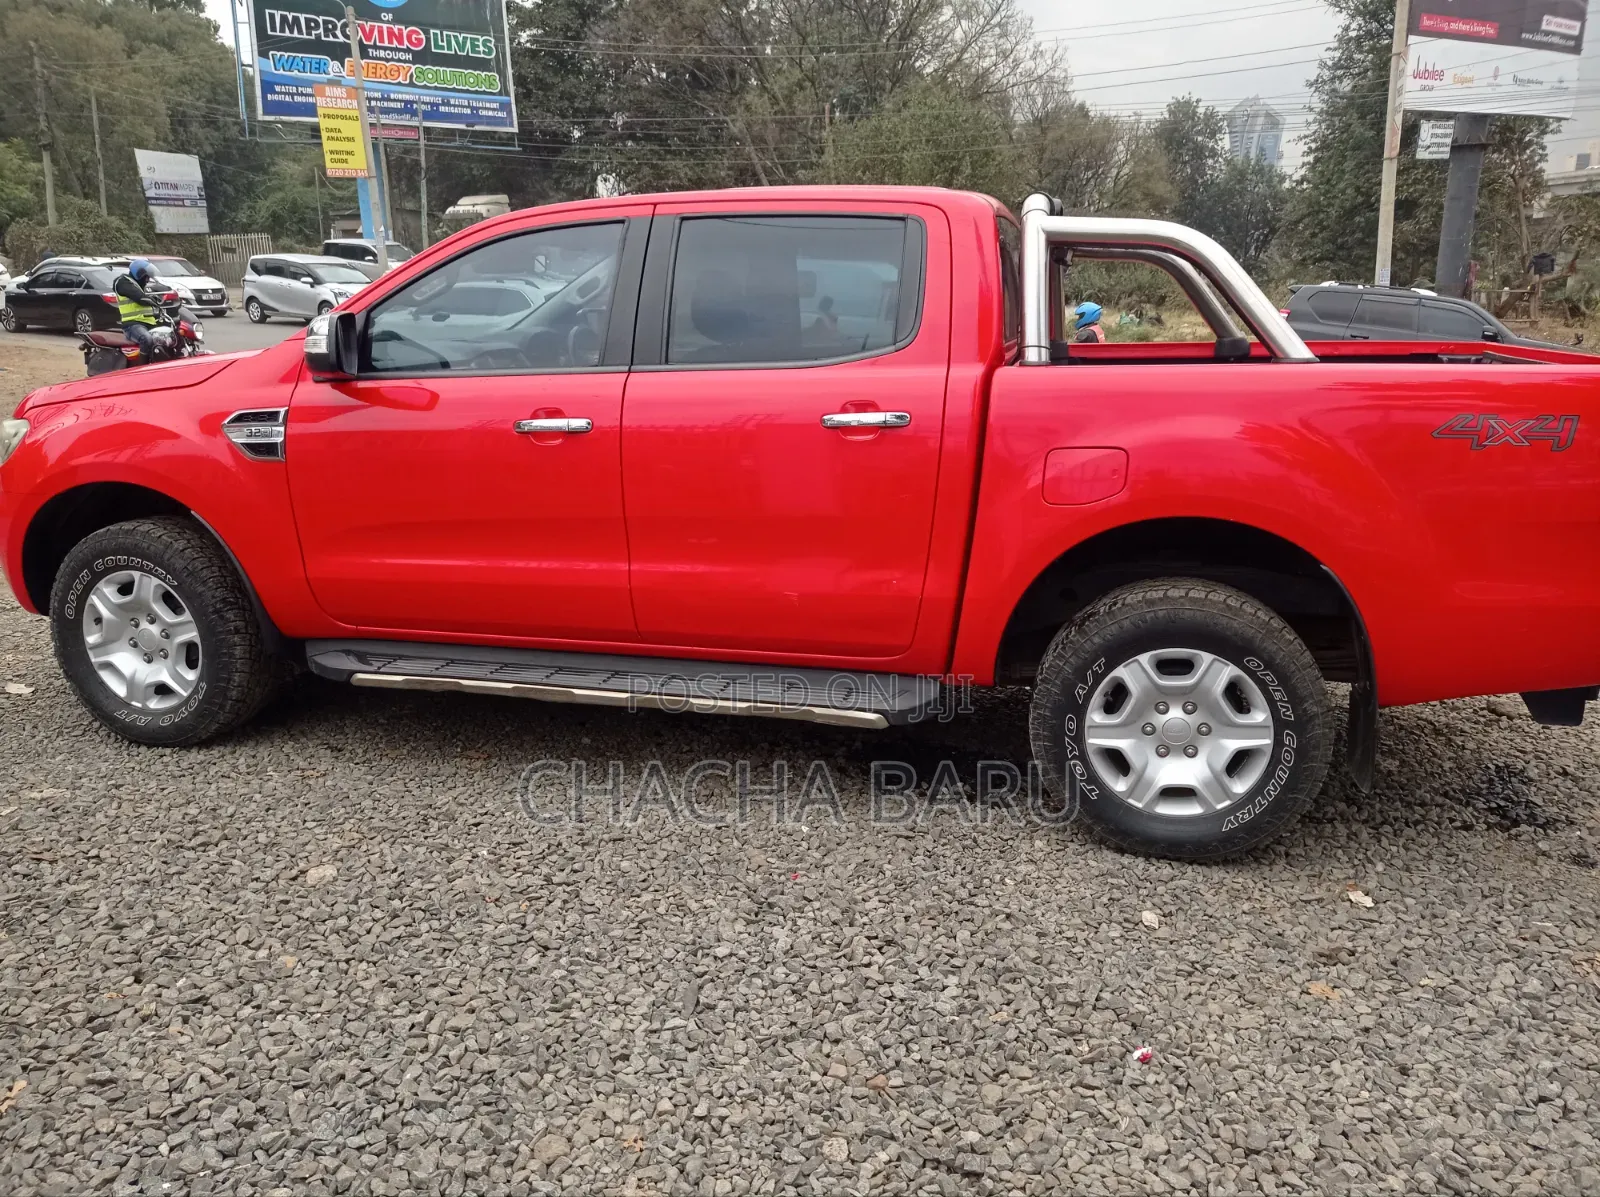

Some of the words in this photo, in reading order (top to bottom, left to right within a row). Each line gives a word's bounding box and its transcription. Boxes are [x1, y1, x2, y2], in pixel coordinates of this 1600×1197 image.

[380, 12, 394, 22] OF
[265, 9, 425, 50] IMPROVING
[430, 29, 496, 58] LIVES
[368, 48, 413, 61] THROUGH
[269, 51, 332, 77] WATER
[345, 57, 413, 83] ENERGY
[413, 64, 501, 93] SOLUTIONS
[1412, 54, 1445, 82] Jubilee
[274, 84, 298, 94] WATER
[298, 86, 316, 94] PUM
[450, 98, 469, 107] WATER
[316, 97, 358, 109] RESEARCH
[325, 86, 347, 98] AIMS
[267, 93, 293, 102] DIGITAL
[413, 103, 431, 112] POLS
[438, 105, 472, 115] IRRIGATION
[322, 113, 359, 122] PROPOSALS
[326, 135, 356, 143] ANALYSIS
[327, 168, 344, 176] 0720
[160, 182, 179, 191] TITAN
[65, 569, 92, 620] OPEN
[94, 555, 178, 586] COUNTRY
[1243, 656, 1295, 722] OPEN
[159, 681, 208, 727] TOYO
[1065, 714, 1100, 800] TOYO
[1222, 730, 1298, 832] COUNTRY
